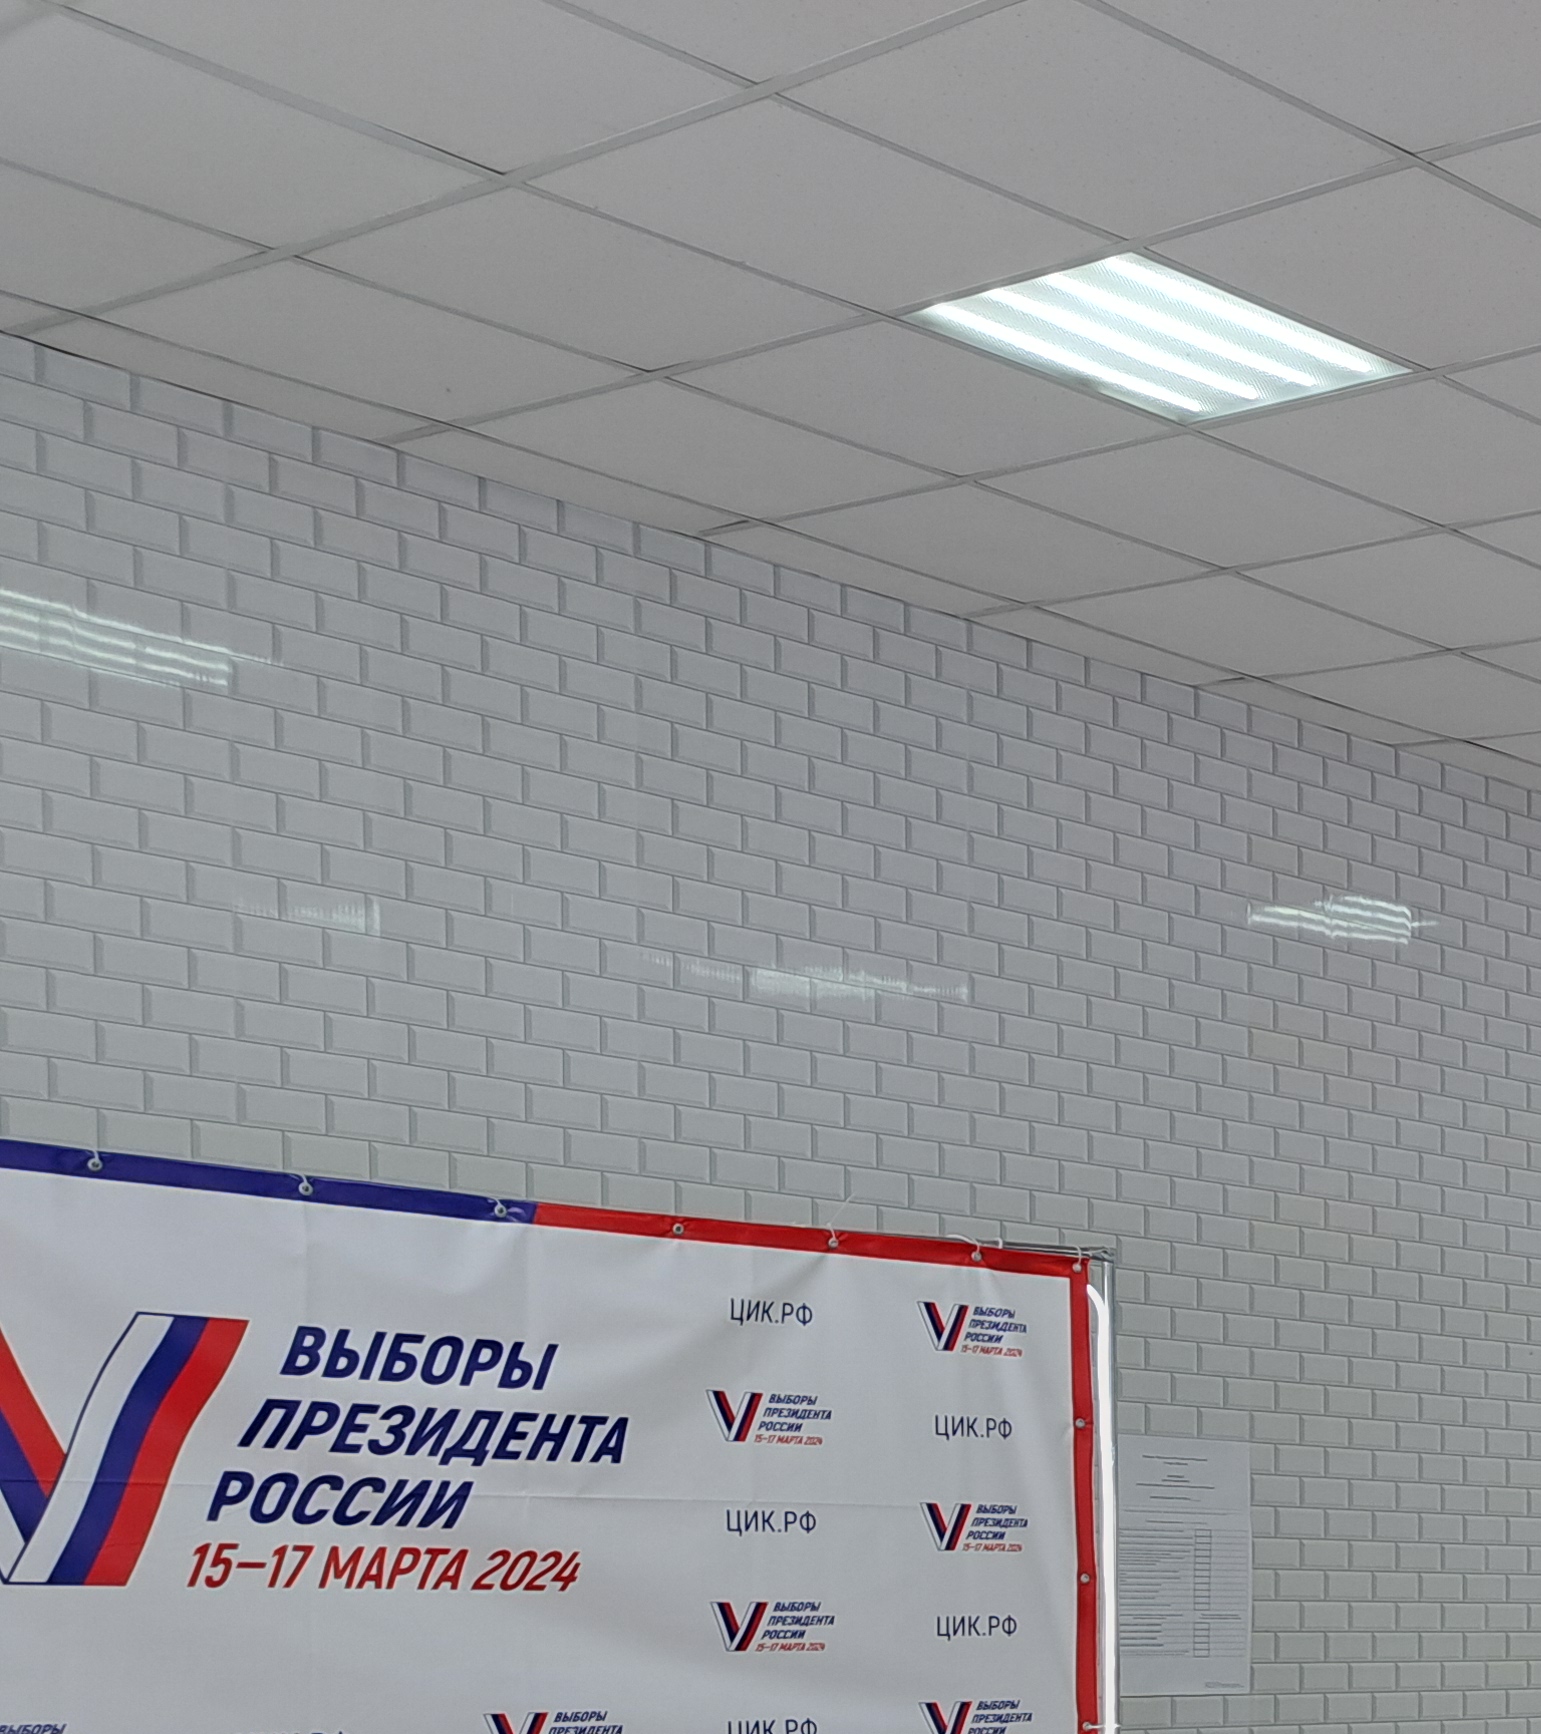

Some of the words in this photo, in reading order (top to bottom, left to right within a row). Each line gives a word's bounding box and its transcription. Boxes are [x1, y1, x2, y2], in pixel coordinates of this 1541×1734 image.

[731, 1298, 812, 1326] ЦИК.РФ
[974, 1306, 1016, 1318] ВЫБОРЫ
[969, 1319, 1028, 1332] ПРЕЗИДЕНТА
[964, 1333, 1003, 1343] РОССИИ
[279, 1325, 559, 1391] ВЫБОРЫ
[769, 1393, 817, 1405] ВЫБОРЫ
[763, 1407, 831, 1420] ПРЕЗИДЕНТА
[237, 1398, 629, 1467] ПРЕЗИДЕНТА
[758, 1422, 802, 1432] РОССИИ
[935, 1415, 1012, 1440] ЦИК.РФ
[206, 1470, 474, 1530] РОССИИ
[976, 1504, 1018, 1514] ВЫБОРЫ
[727, 1510, 816, 1536] ЦИК.РФ
[971, 1518, 1030, 1528] ПРЕЗИДЕНТА
[966, 1531, 1005, 1540] РОССИИ
[318, 1545, 469, 1591] МАРТА
[470, 1549, 581, 1592] 2024
[773, 1602, 822, 1611] ВЫБОРЫ
[767, 1616, 835, 1626] ПРЕЗИДЕНТА
[937, 1615, 1017, 1641] ЦИК.РФ
[761, 1630, 805, 1639] РОССИИ
[976, 1700, 1019, 1710] ВЫБОРЫ
[554, 1711, 607, 1722] ВЫБОРЫ
[972, 1713, 1032, 1724] ПРЕЗИДЕНТА
